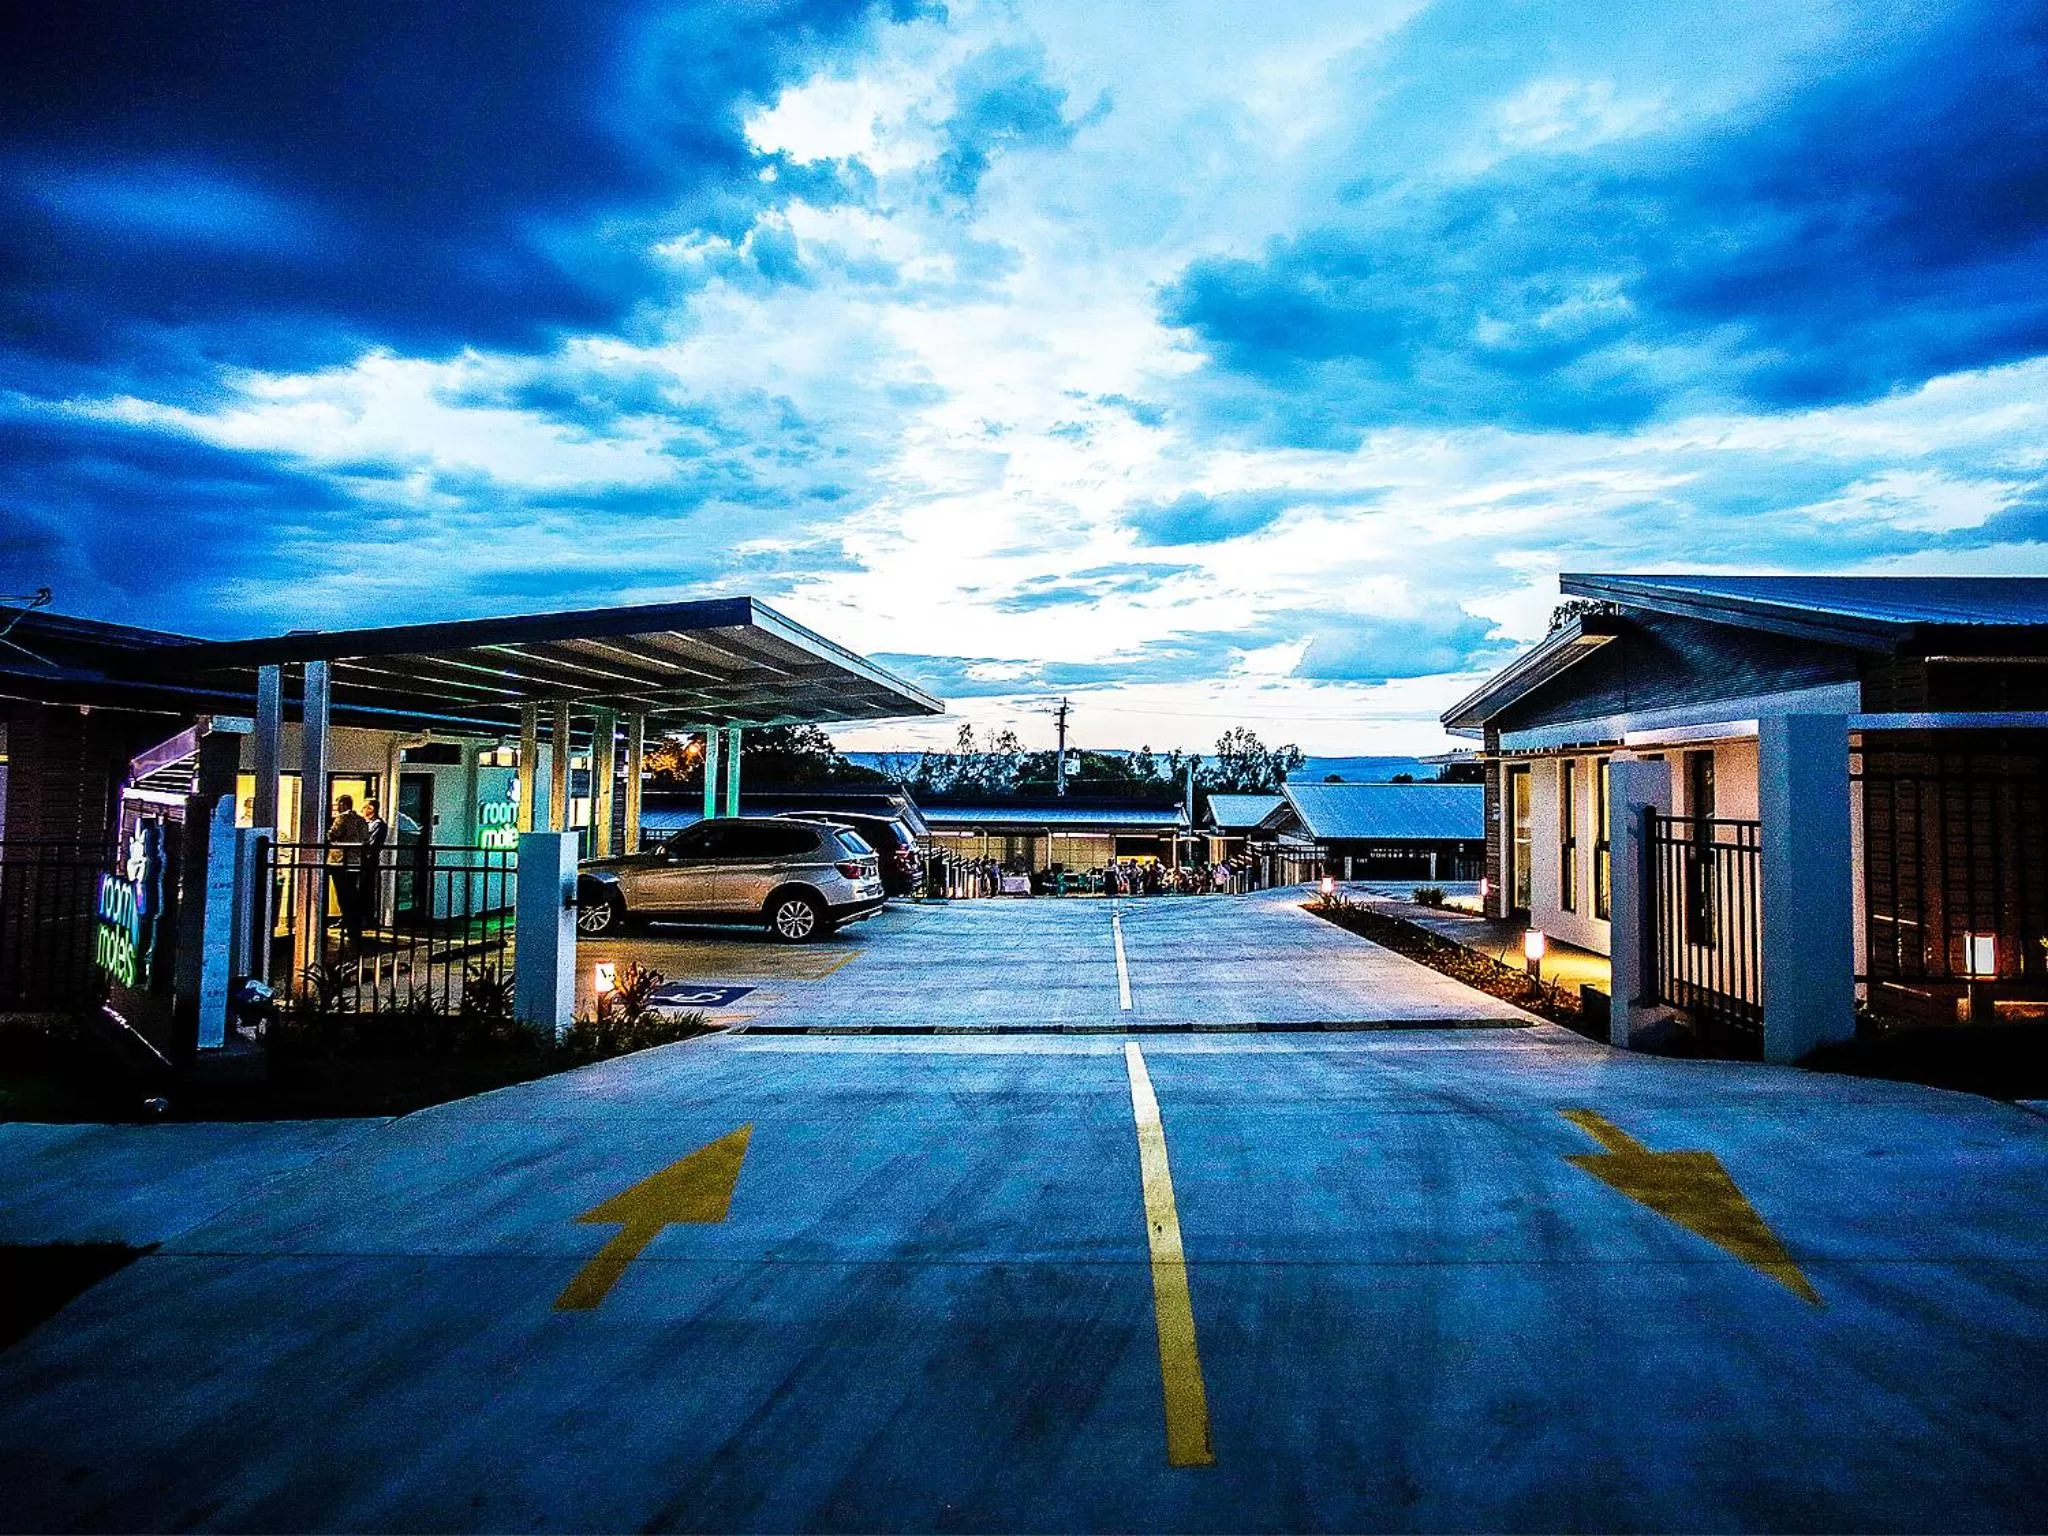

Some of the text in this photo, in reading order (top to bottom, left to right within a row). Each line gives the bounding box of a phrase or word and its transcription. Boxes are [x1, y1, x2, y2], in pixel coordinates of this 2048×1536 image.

[481, 824, 520, 849] mote
[99, 873, 133, 929] room
[96, 922, 136, 988] motels
